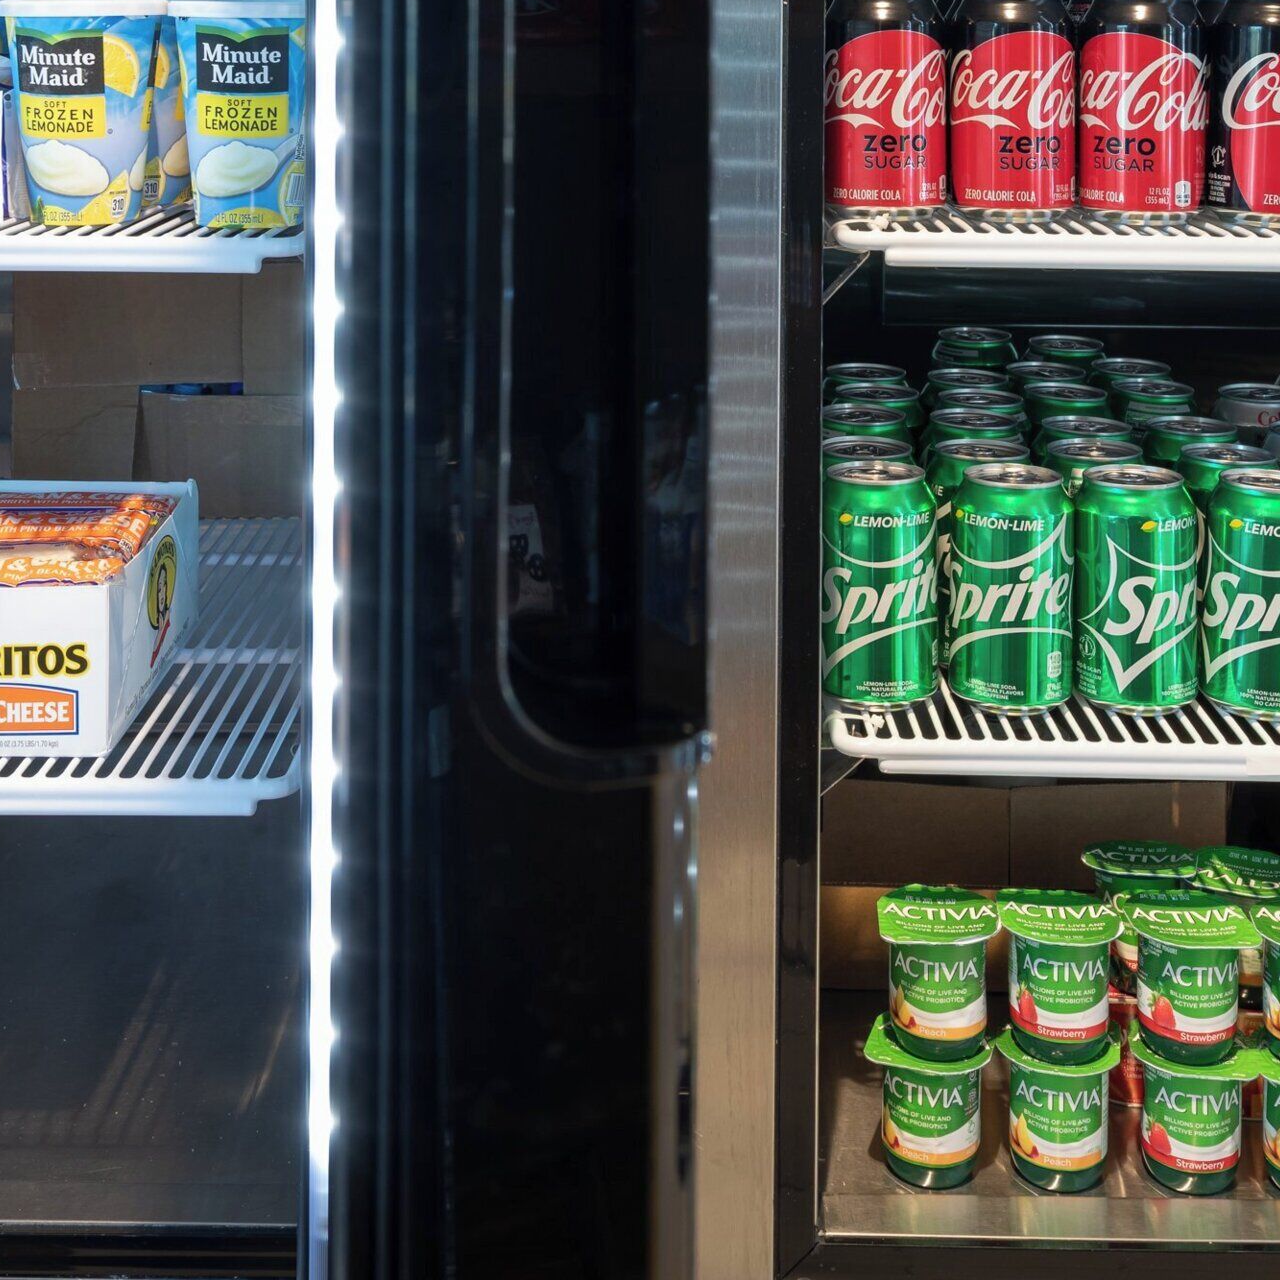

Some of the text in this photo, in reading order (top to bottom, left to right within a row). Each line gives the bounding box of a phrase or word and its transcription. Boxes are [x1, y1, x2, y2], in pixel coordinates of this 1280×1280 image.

[21, 44, 96, 66] Minute
[201, 41, 281, 65] Minute
[29, 65, 84, 87] Maid
[211, 62, 270, 85] Maid
[43, 100, 67, 109] SOFT
[227, 98, 252, 107] SOFT
[26, 107, 94, 120] FROZEN
[205, 105, 277, 118] FROZEN
[26, 120, 94, 133] LEMONADE
[205, 118, 278, 132] LEMONADE
[999, 135, 1061, 154] zero
[1093, 135, 1156, 155] zero
[999, 156, 1060, 170] SUGAR
[1094, 156, 1154, 172] SUGAR
[965, 189, 1036, 202] ZERO CALORIE COLA
[112, 197, 124, 210] 310
[853, 512, 930, 528] LEMON-LIME
[964, 513, 1045, 531] LEMON-LIME
[894, 955, 976, 983] ACTIVIA
[1023, 953, 1105, 983] ACTIVIA
[1029, 982, 1055, 996] BILLIONS
[1032, 991, 1094, 1005] ACTIVE PROBIOTICS
[919, 1025, 947, 1038] Peach
[1037, 1025, 1087, 1040] Strawberry
[1180, 1030, 1227, 1043] Strawberry
[884, 1070, 962, 1109] ACTIVIA
[1016, 1079, 1101, 1110] ACTIVIA
[1043, 1155, 1071, 1168] Peach
[1176, 1158, 1225, 1172] Strawberry
